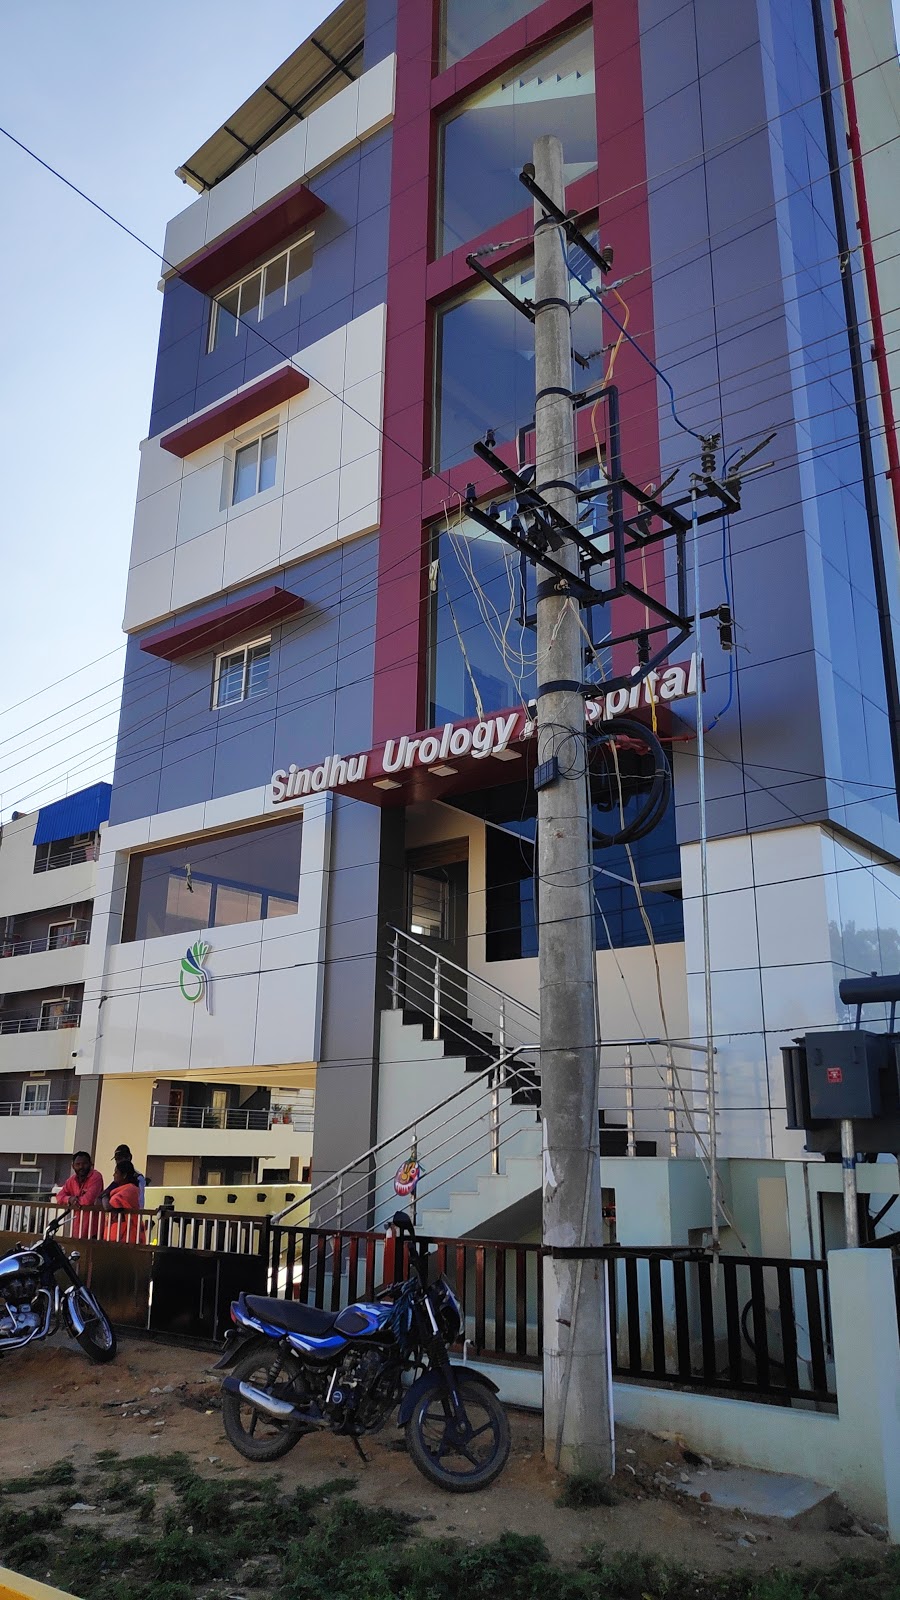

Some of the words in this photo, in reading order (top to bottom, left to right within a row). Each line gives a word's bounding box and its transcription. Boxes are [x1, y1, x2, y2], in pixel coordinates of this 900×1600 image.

[271, 754, 368, 804] Sindhu
[382, 712, 520, 773] Urology
[526, 651, 704, 738] spital
